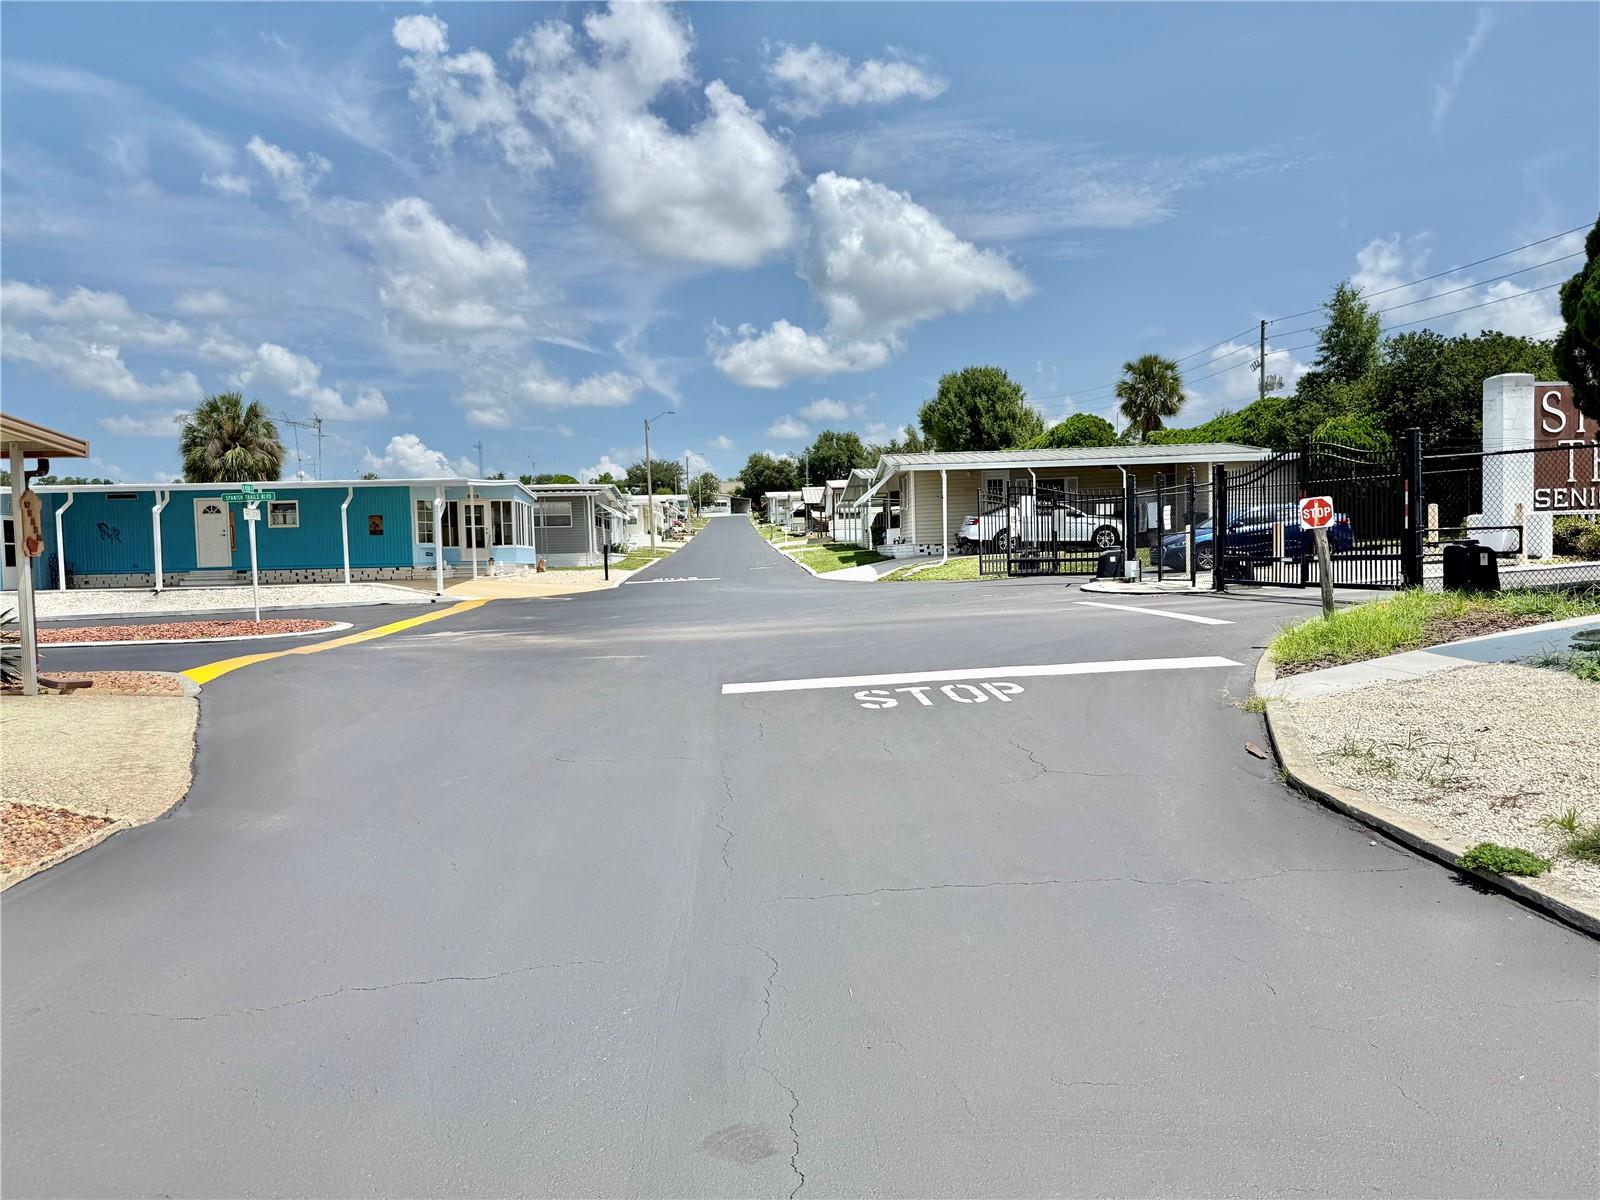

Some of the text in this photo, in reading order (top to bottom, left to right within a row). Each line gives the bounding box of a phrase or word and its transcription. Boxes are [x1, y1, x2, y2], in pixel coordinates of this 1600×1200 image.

[1534, 487, 1600, 508] SENI
[1303, 506, 1331, 519] STOP
[853, 682, 1025, 709] STOP
